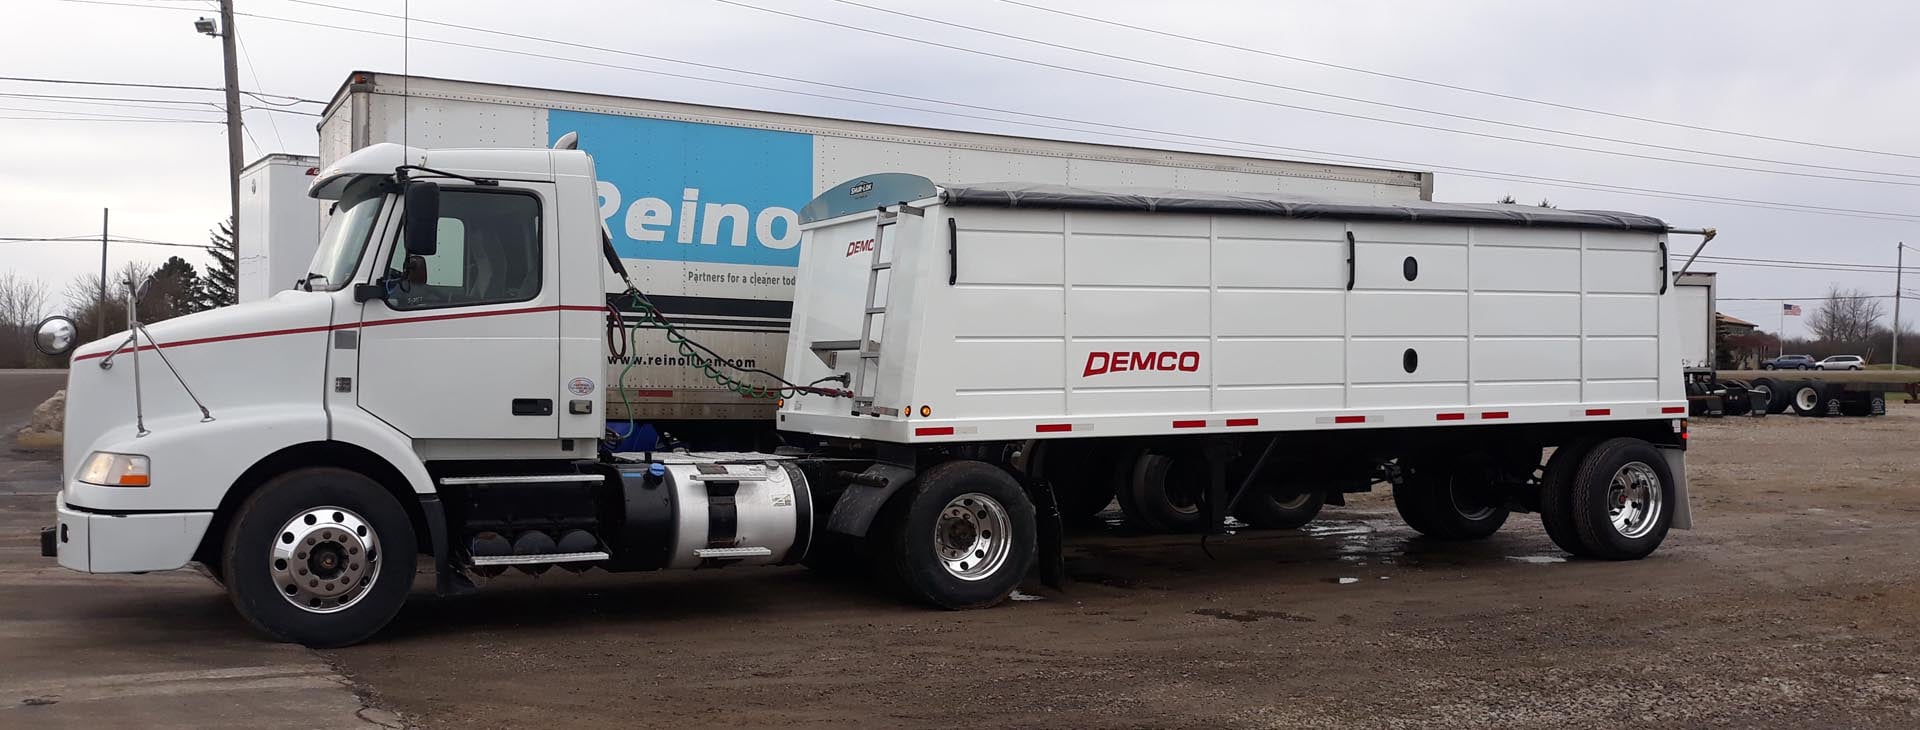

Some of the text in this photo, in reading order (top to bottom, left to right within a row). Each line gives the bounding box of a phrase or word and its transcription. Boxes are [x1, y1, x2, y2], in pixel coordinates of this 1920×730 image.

[597, 181, 801, 249] Reino
[846, 239, 874, 257] DEMC
[688, 271, 796, 286] Partners for a cleaner tod
[1083, 351, 1200, 378] DEMCO
